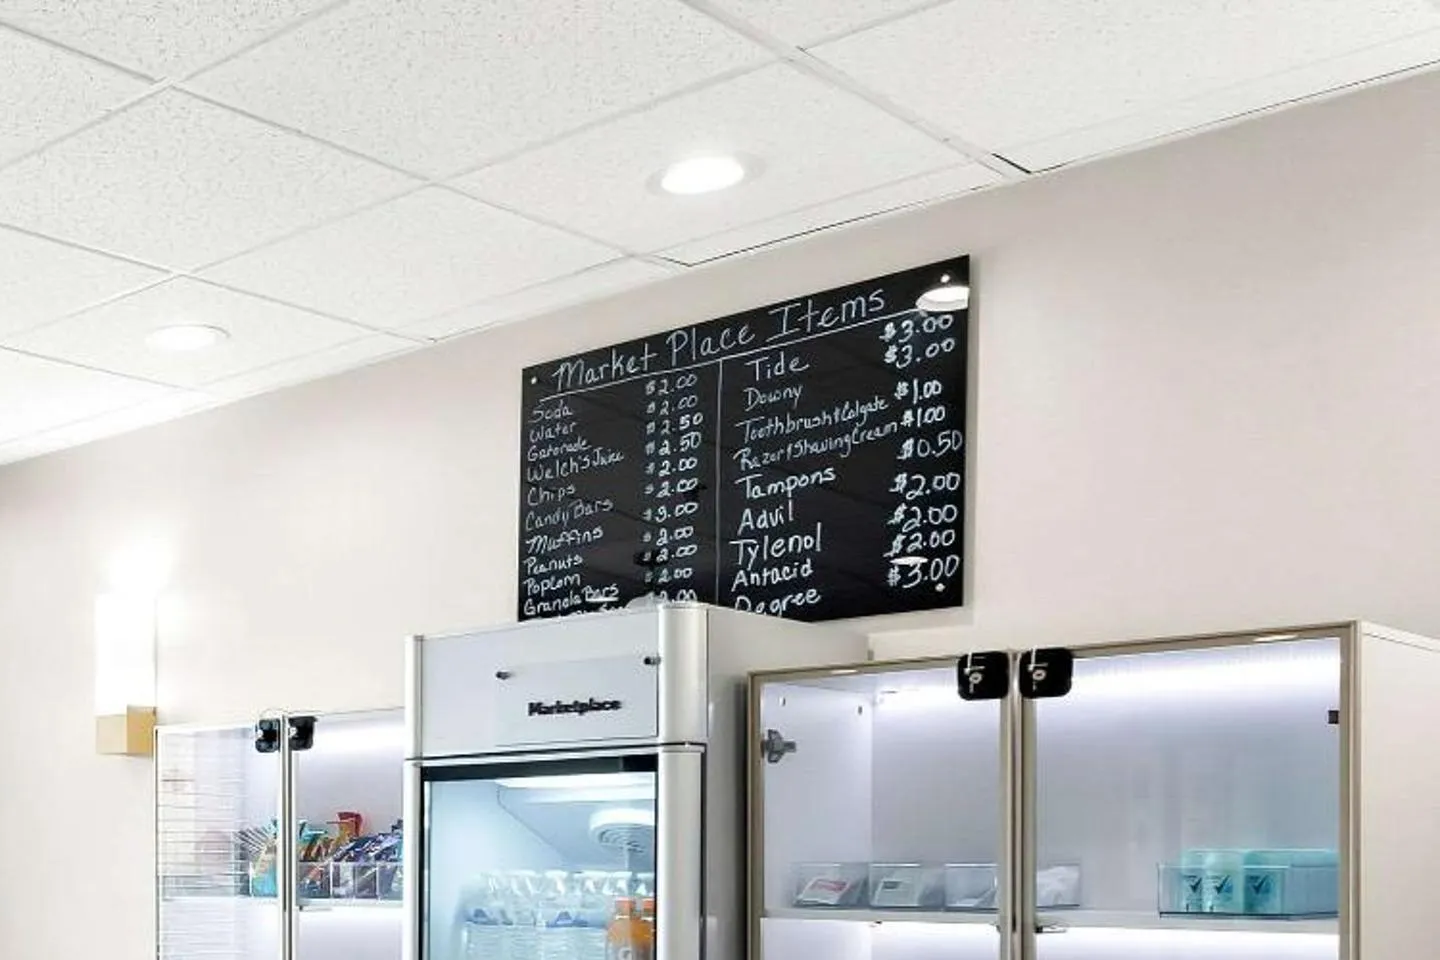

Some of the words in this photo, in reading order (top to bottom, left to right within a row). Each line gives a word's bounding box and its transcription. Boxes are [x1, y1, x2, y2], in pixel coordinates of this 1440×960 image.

[551, 342, 658, 391] Market
[666, 323, 755, 366] Place
[766, 288, 885, 343] Items
[745, 351, 810, 381] Tide
[879, 314, 953, 342] $3.00
[742, 384, 803, 411] Downy
[884, 337, 955, 369] $3.00
[894, 379, 942, 404] $1.00
[528, 399, 573, 423] Soda
[528, 436, 592, 461] Gatorade
[529, 422, 577, 443] Water
[527, 456, 591, 482] Welch's
[734, 467, 837, 500] Tampons
[896, 429, 962, 460] $0.50
[527, 484, 575, 506] Chips
[736, 500, 794, 535] Advil
[888, 471, 960, 500] $2.00
[526, 507, 570, 532] Candy
[568, 498, 613, 520] Bars
[525, 526, 603, 554] Muffins
[729, 522, 822, 569] Tylenol
[886, 503, 958, 533] $2.00
[523, 554, 583, 575] Peanuts
[731, 558, 813, 592] Antacid
[882, 529, 955, 557] $2.00
[523, 590, 582, 615] Granola
[581, 583, 619, 600] Bars
[734, 588, 822, 618] Degree
[887, 555, 959, 589] $3.00
[527, 697, 622, 717] Marketplace
